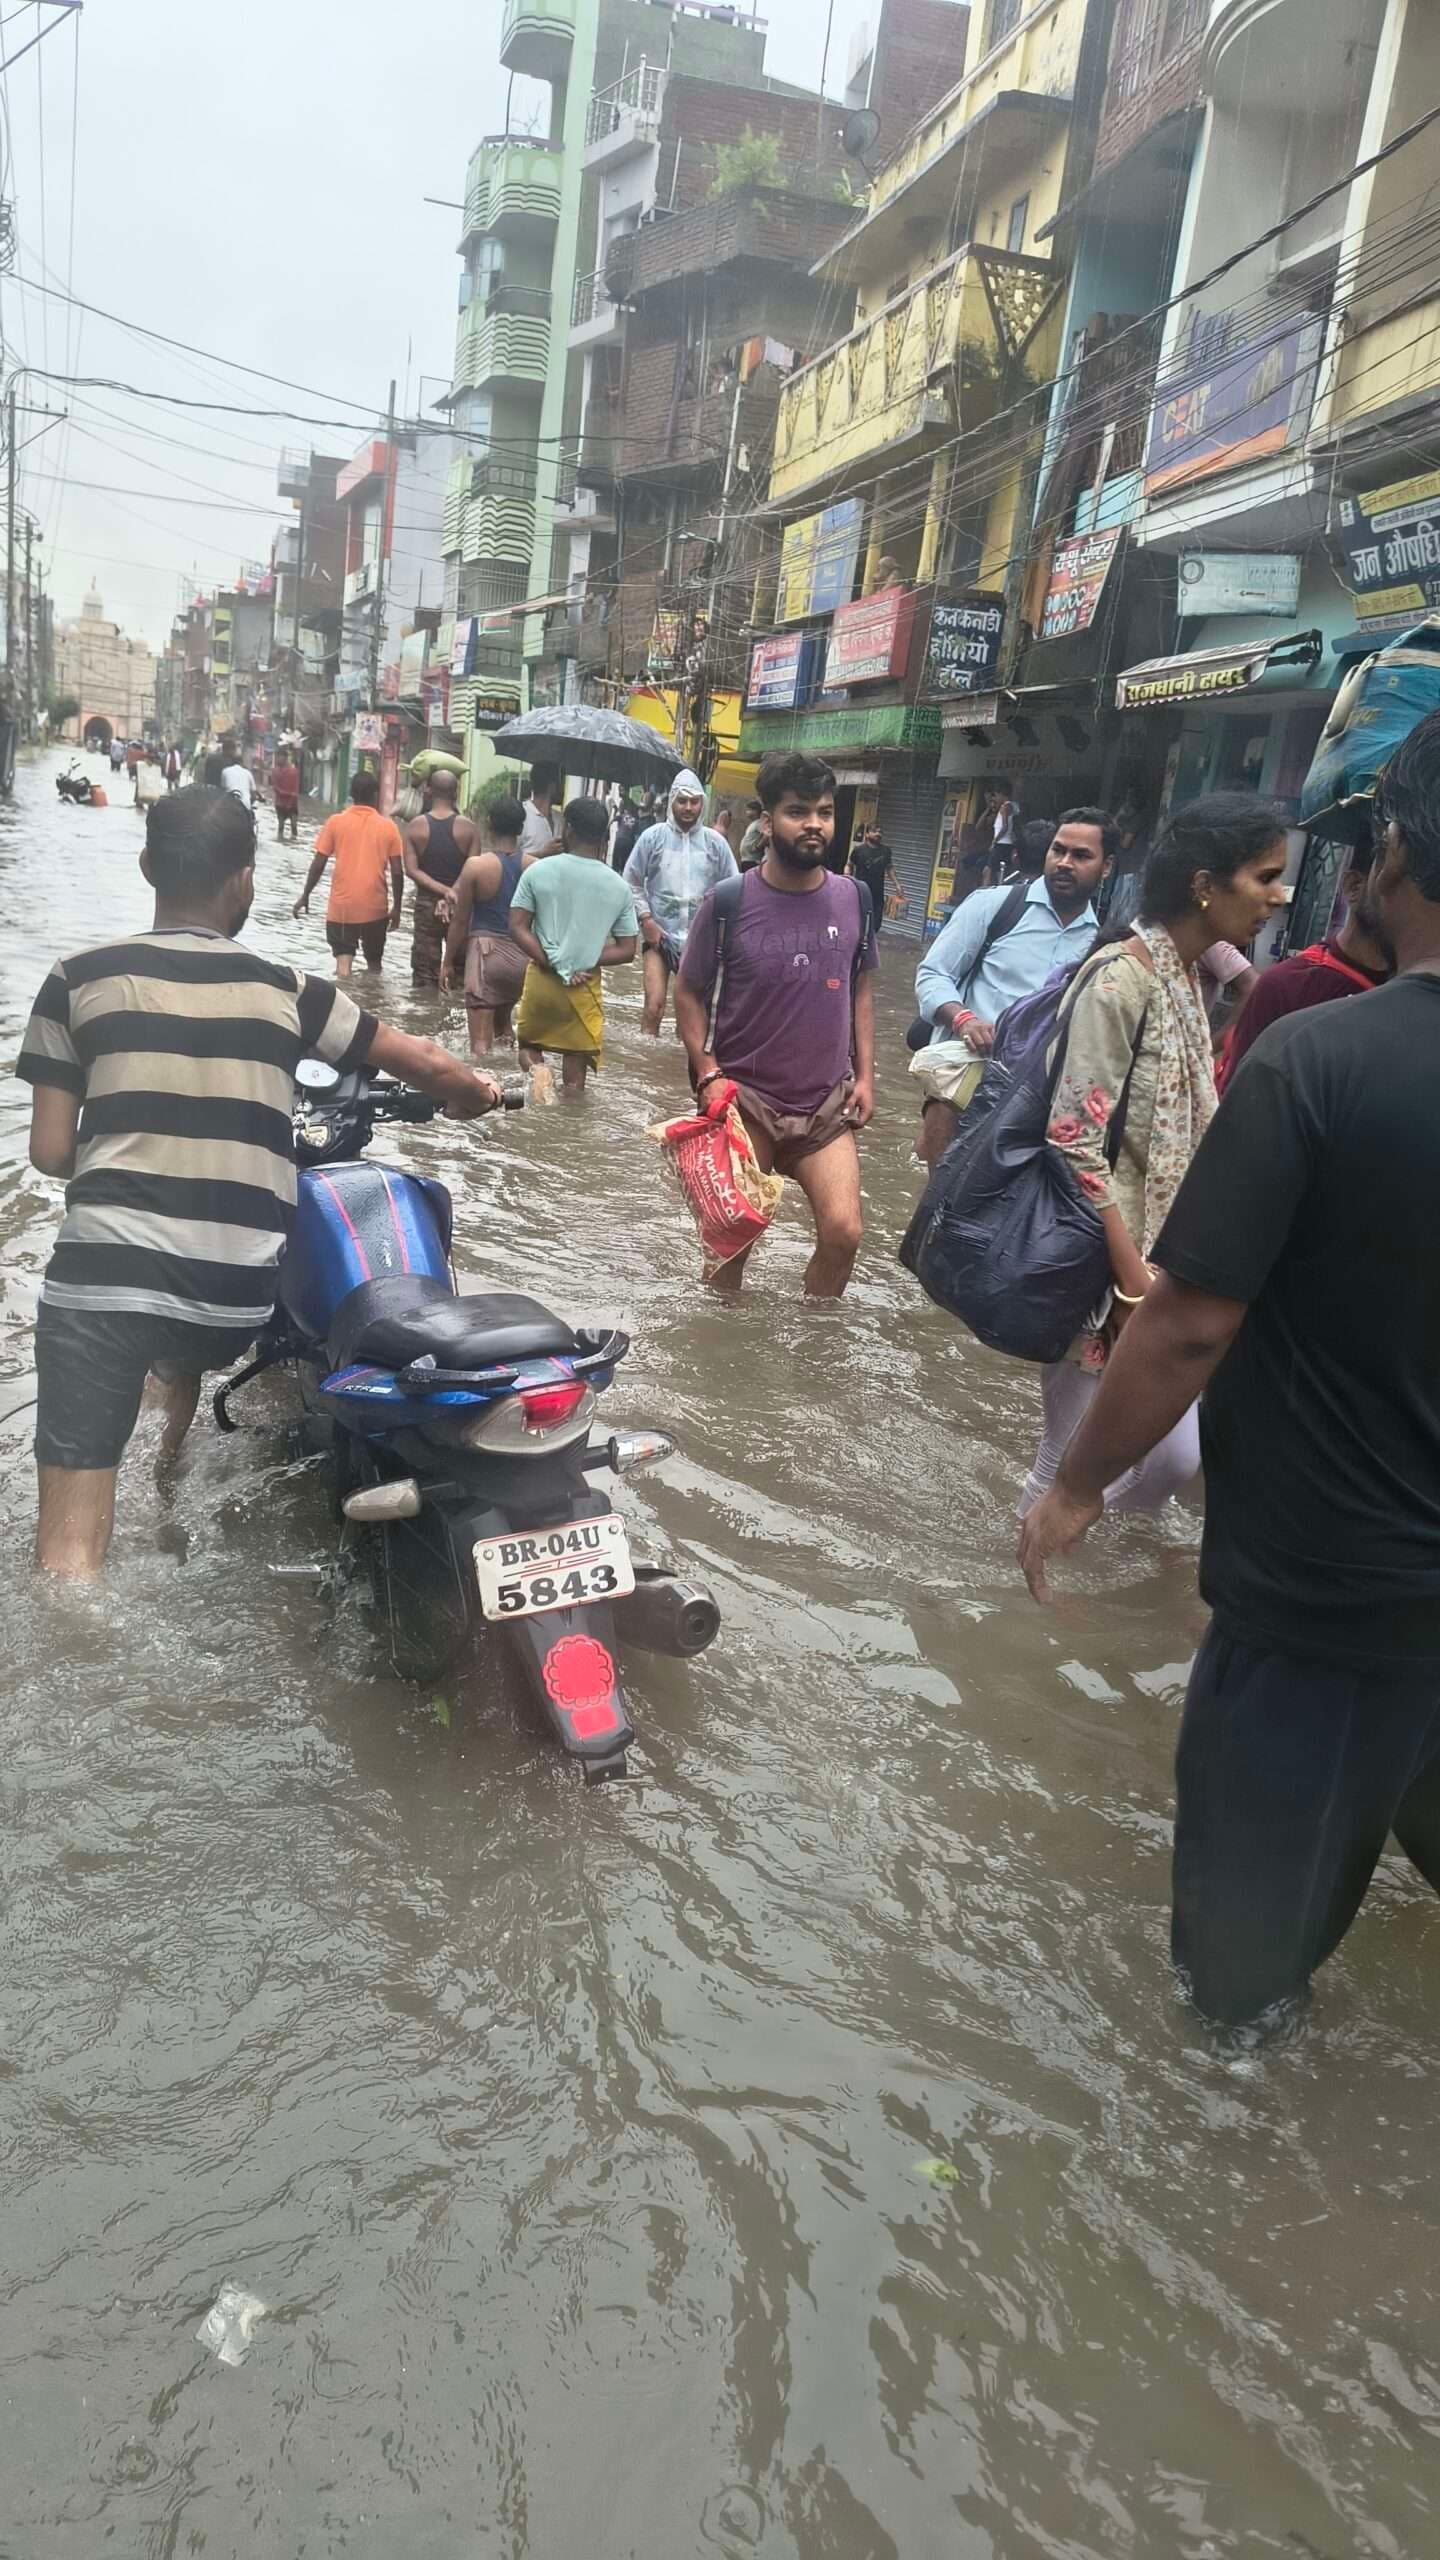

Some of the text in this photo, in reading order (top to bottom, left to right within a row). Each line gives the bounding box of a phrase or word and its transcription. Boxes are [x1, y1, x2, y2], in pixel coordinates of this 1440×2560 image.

[1350, 546, 1381, 582] जन
[1126, 671, 1197, 700] राजधानी
[499, 1526, 600, 1566] BR-04U
[498, 1565, 618, 1612] 5843
